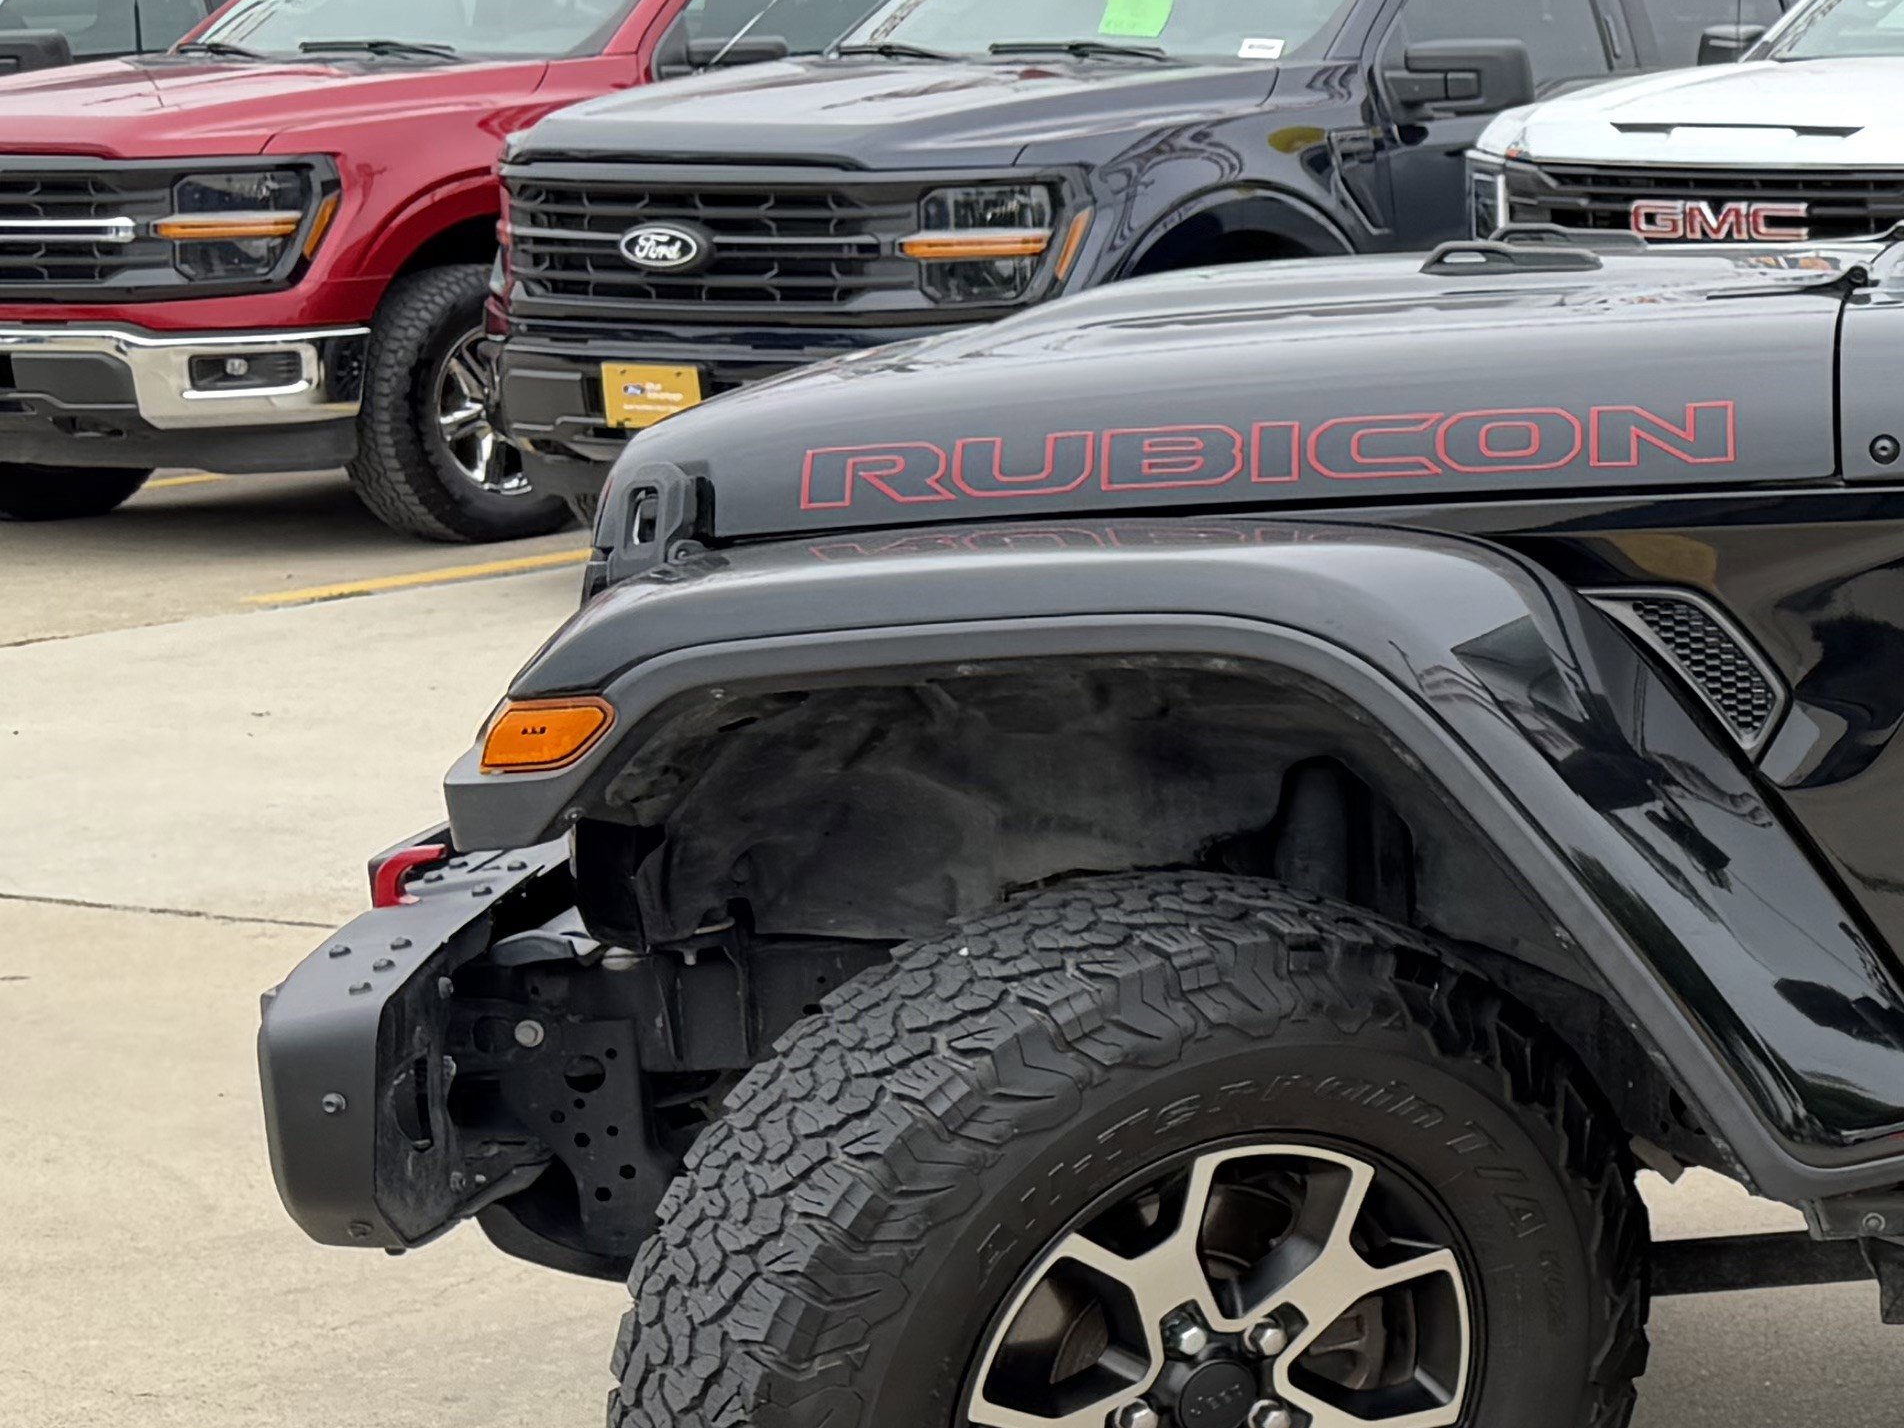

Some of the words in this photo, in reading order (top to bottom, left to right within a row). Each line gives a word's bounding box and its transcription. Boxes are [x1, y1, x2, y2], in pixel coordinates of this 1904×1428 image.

[1630, 199, 1809, 240] GMC
[634, 232, 683, 260] Ford
[799, 400, 1736, 510] RUBICON
